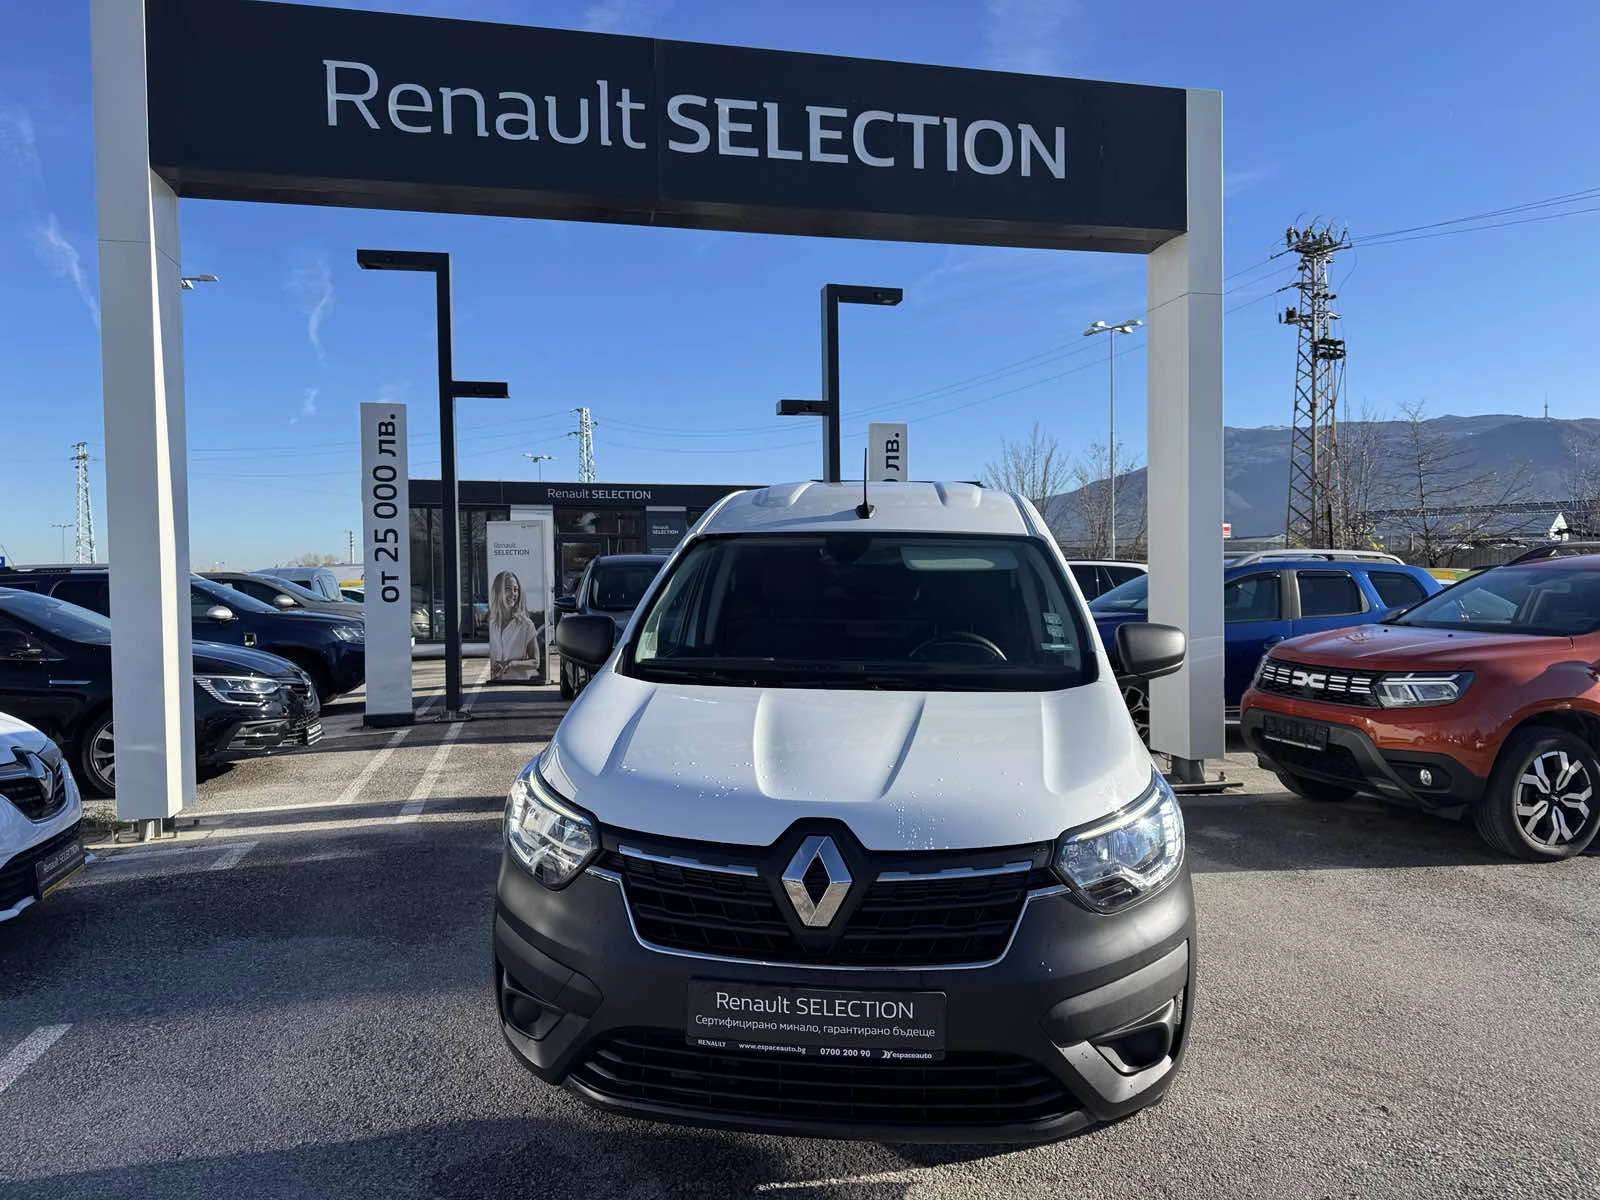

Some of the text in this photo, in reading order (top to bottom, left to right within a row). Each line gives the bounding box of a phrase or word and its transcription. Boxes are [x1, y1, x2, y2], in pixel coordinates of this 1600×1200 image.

[322, 59, 1067, 180] Renault SELECTION
[885, 432, 900, 471] лв.
[547, 488, 652, 500] Renault SELECTION
[372, 413, 400, 603] от 25 000 лв.
[493, 548, 530, 556] SELECTION
[716, 992, 914, 1019] Renault SELECTION
[695, 1014, 936, 1038] Сертифицирано минало, гарантирано бъдеще
[697, 1039, 933, 1060] RENAULT www.espaceauto.bg 0700 200 90 espaceauto
